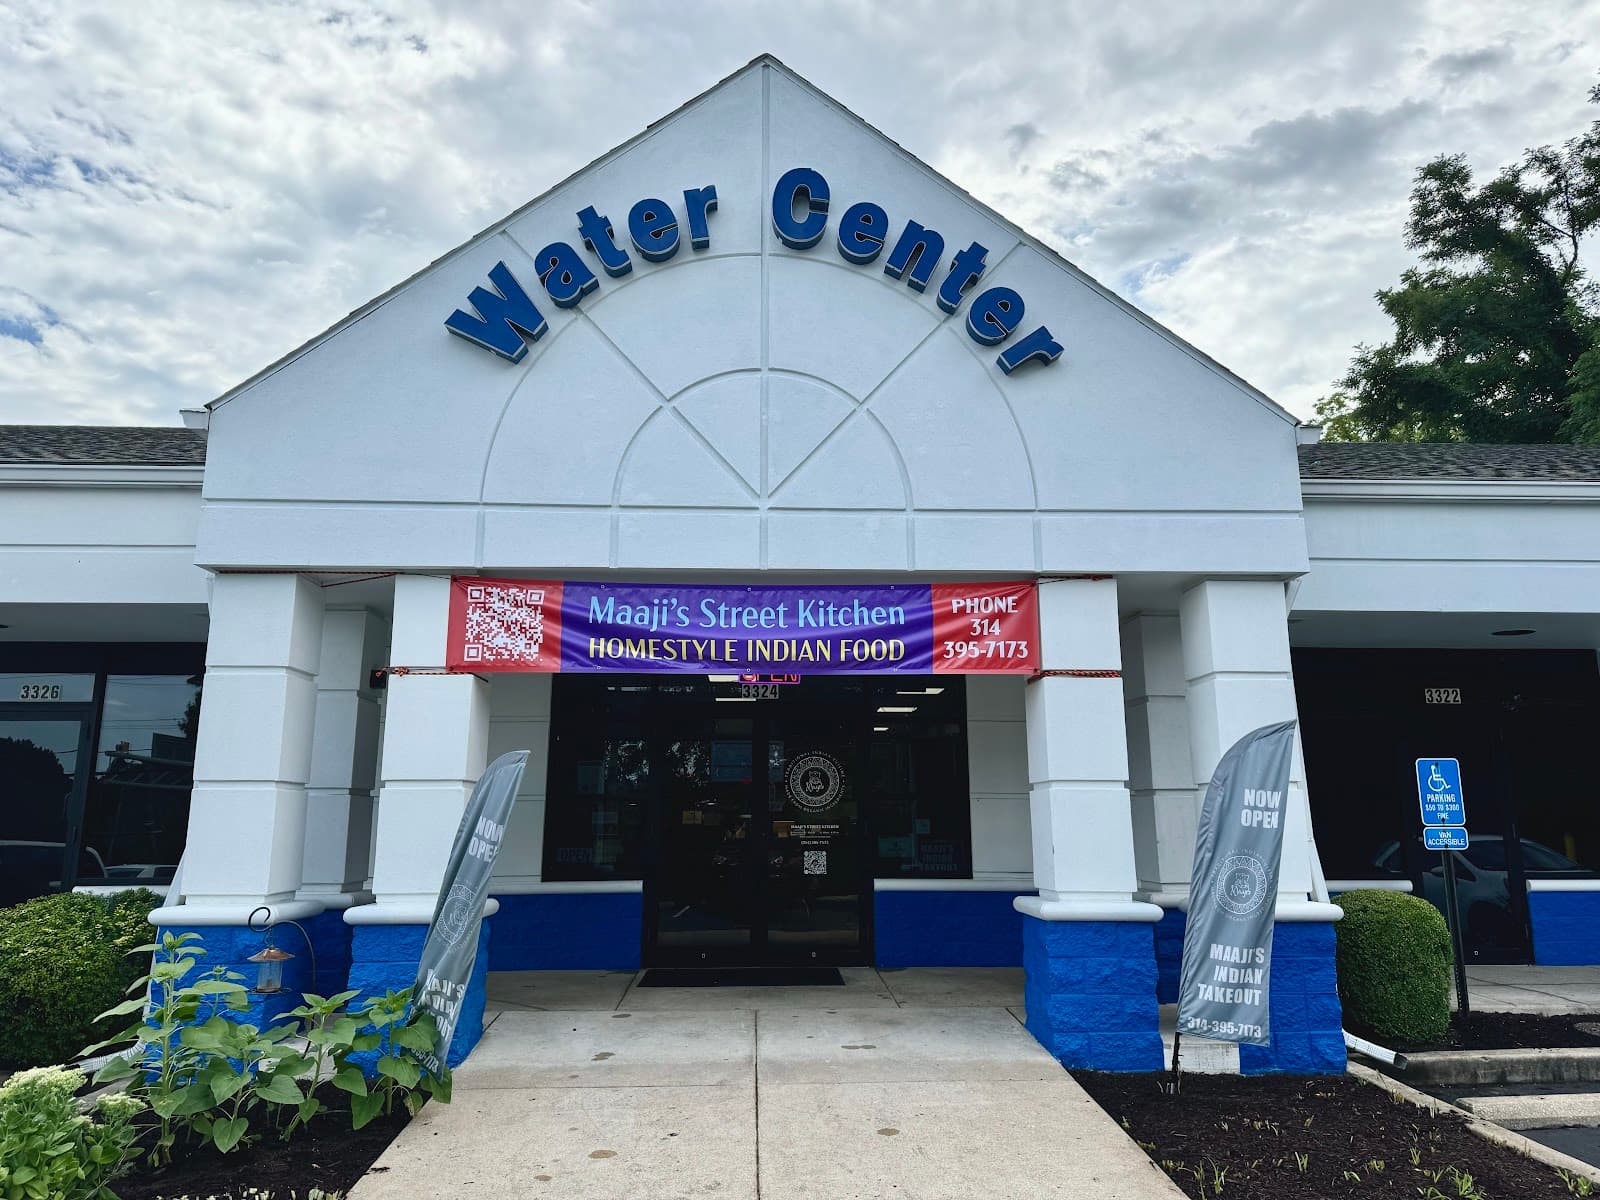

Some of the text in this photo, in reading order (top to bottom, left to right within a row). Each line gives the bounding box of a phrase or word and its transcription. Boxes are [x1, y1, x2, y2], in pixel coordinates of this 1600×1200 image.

[444, 167, 1064, 376] Water Center
[588, 595, 906, 632] Maaji's Street Kitchen
[951, 596, 1018, 614] PHONE
[970, 618, 1001, 636] 314
[588, 638, 906, 662] HOMESTYLE INDIAN FOOD
[943, 640, 1028, 660] 395-7173
[21, 685, 59, 699] 3326
[743, 685, 778, 698] 3324
[1426, 689, 1460, 703] 3322
[1244, 789, 1281, 808] NOW
[1427, 794, 1456, 803] PARKING
[1241, 809, 1278, 829] OPEN
[1428, 838, 1465, 846] ACCESSIBLE
[1209, 943, 1265, 964] MAAJI'S
[1213, 965, 1263, 985] INDIAN
[1197, 983, 1262, 1006] TAKEOUT
[1187, 1016, 1262, 1038] 314-395-7173
